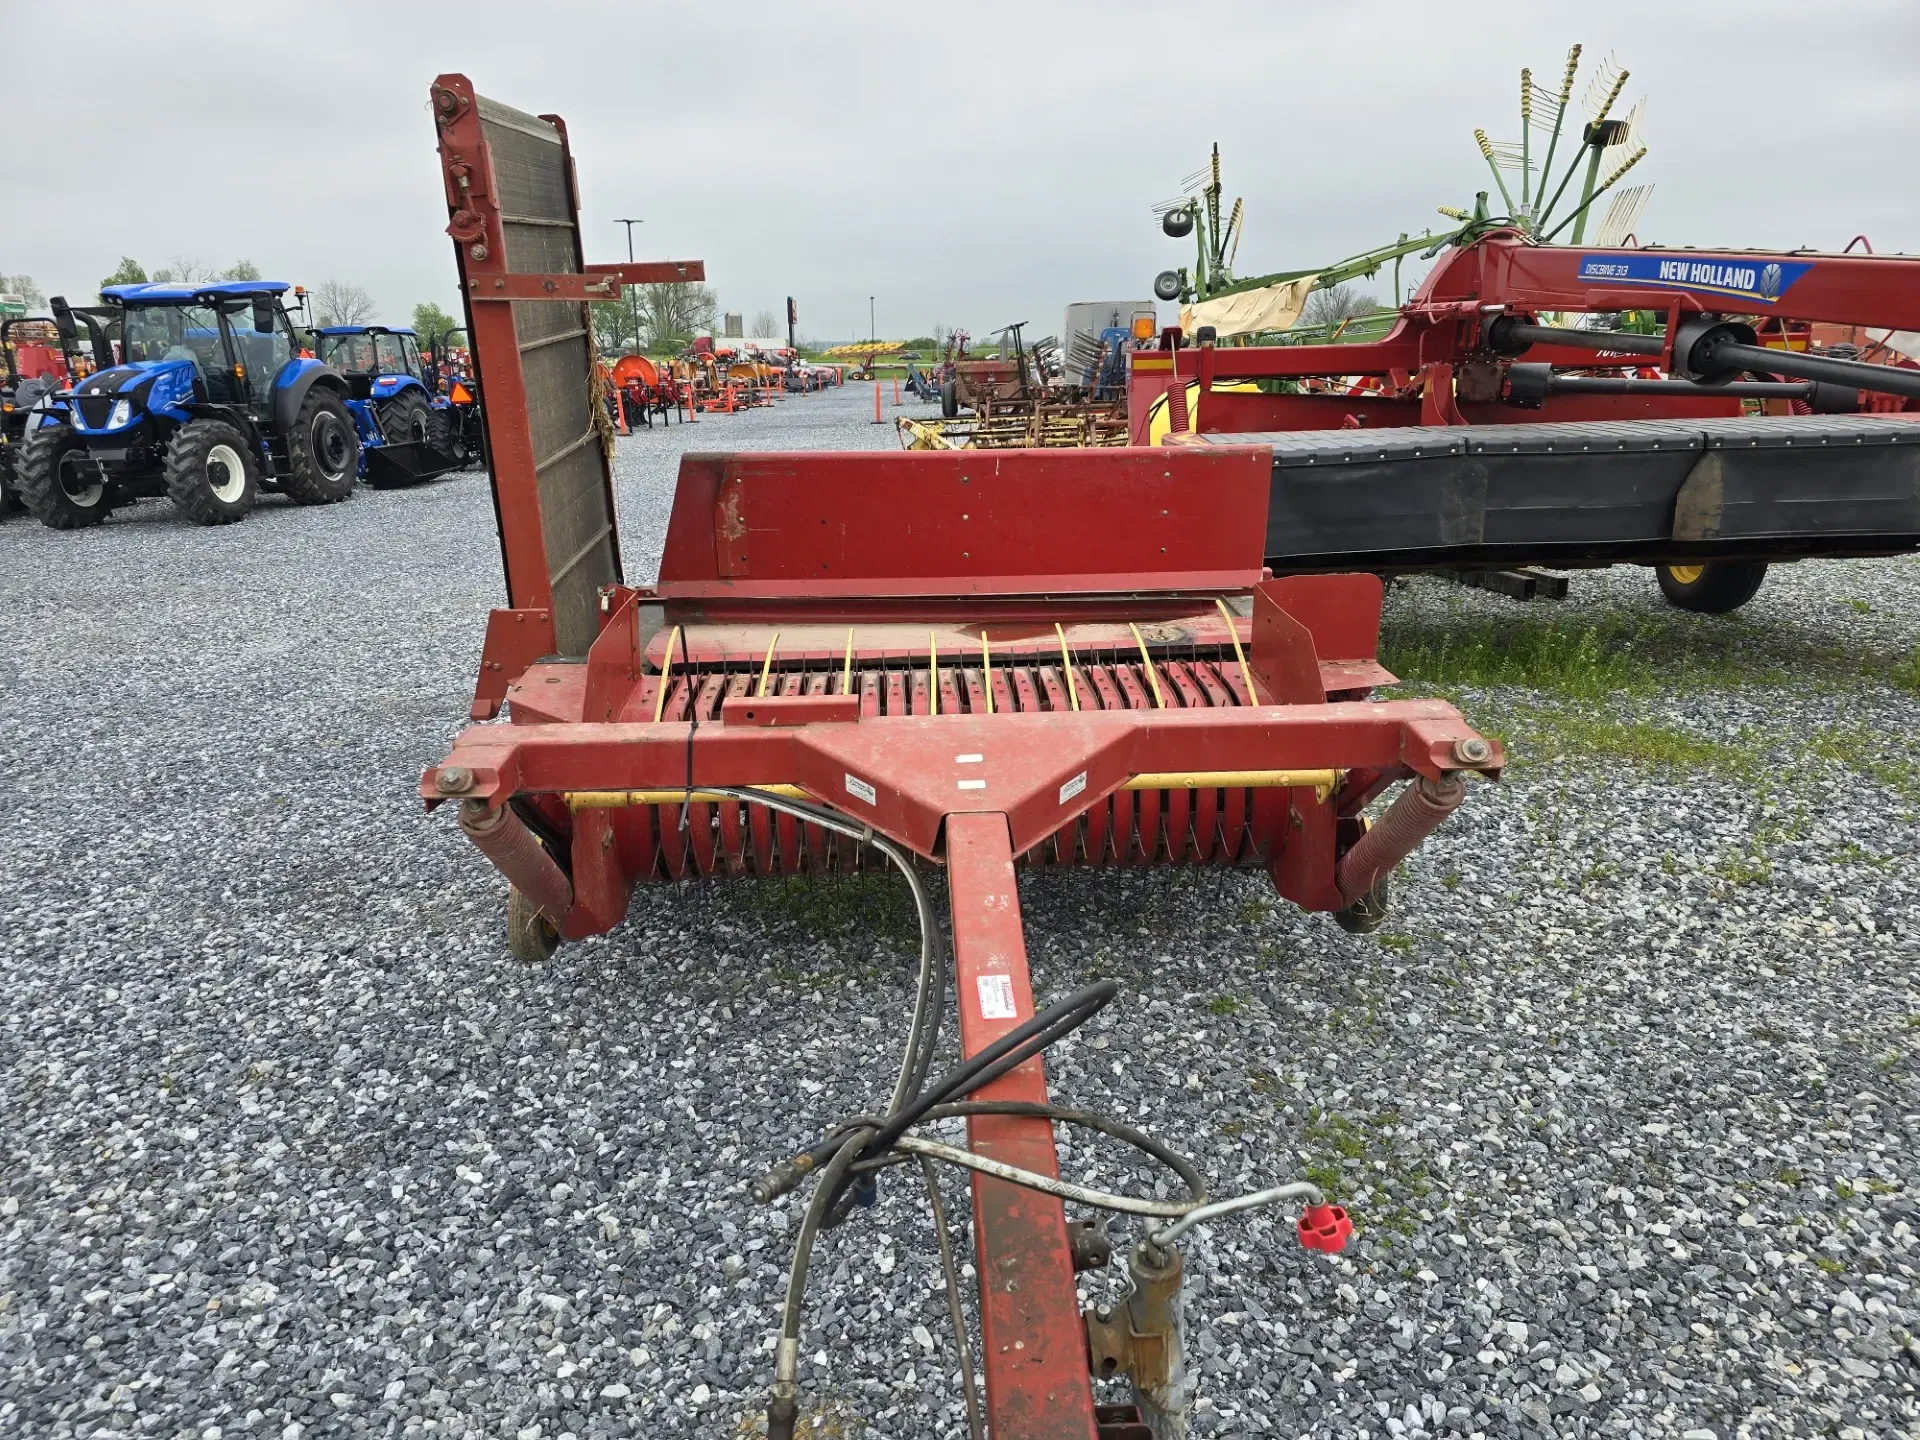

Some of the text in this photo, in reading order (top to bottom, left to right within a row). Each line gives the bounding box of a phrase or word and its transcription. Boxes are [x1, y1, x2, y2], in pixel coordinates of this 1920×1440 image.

[1585, 263, 1628, 276] DISCBINE 313
[1659, 260, 1756, 290] NEW HOLLAND
